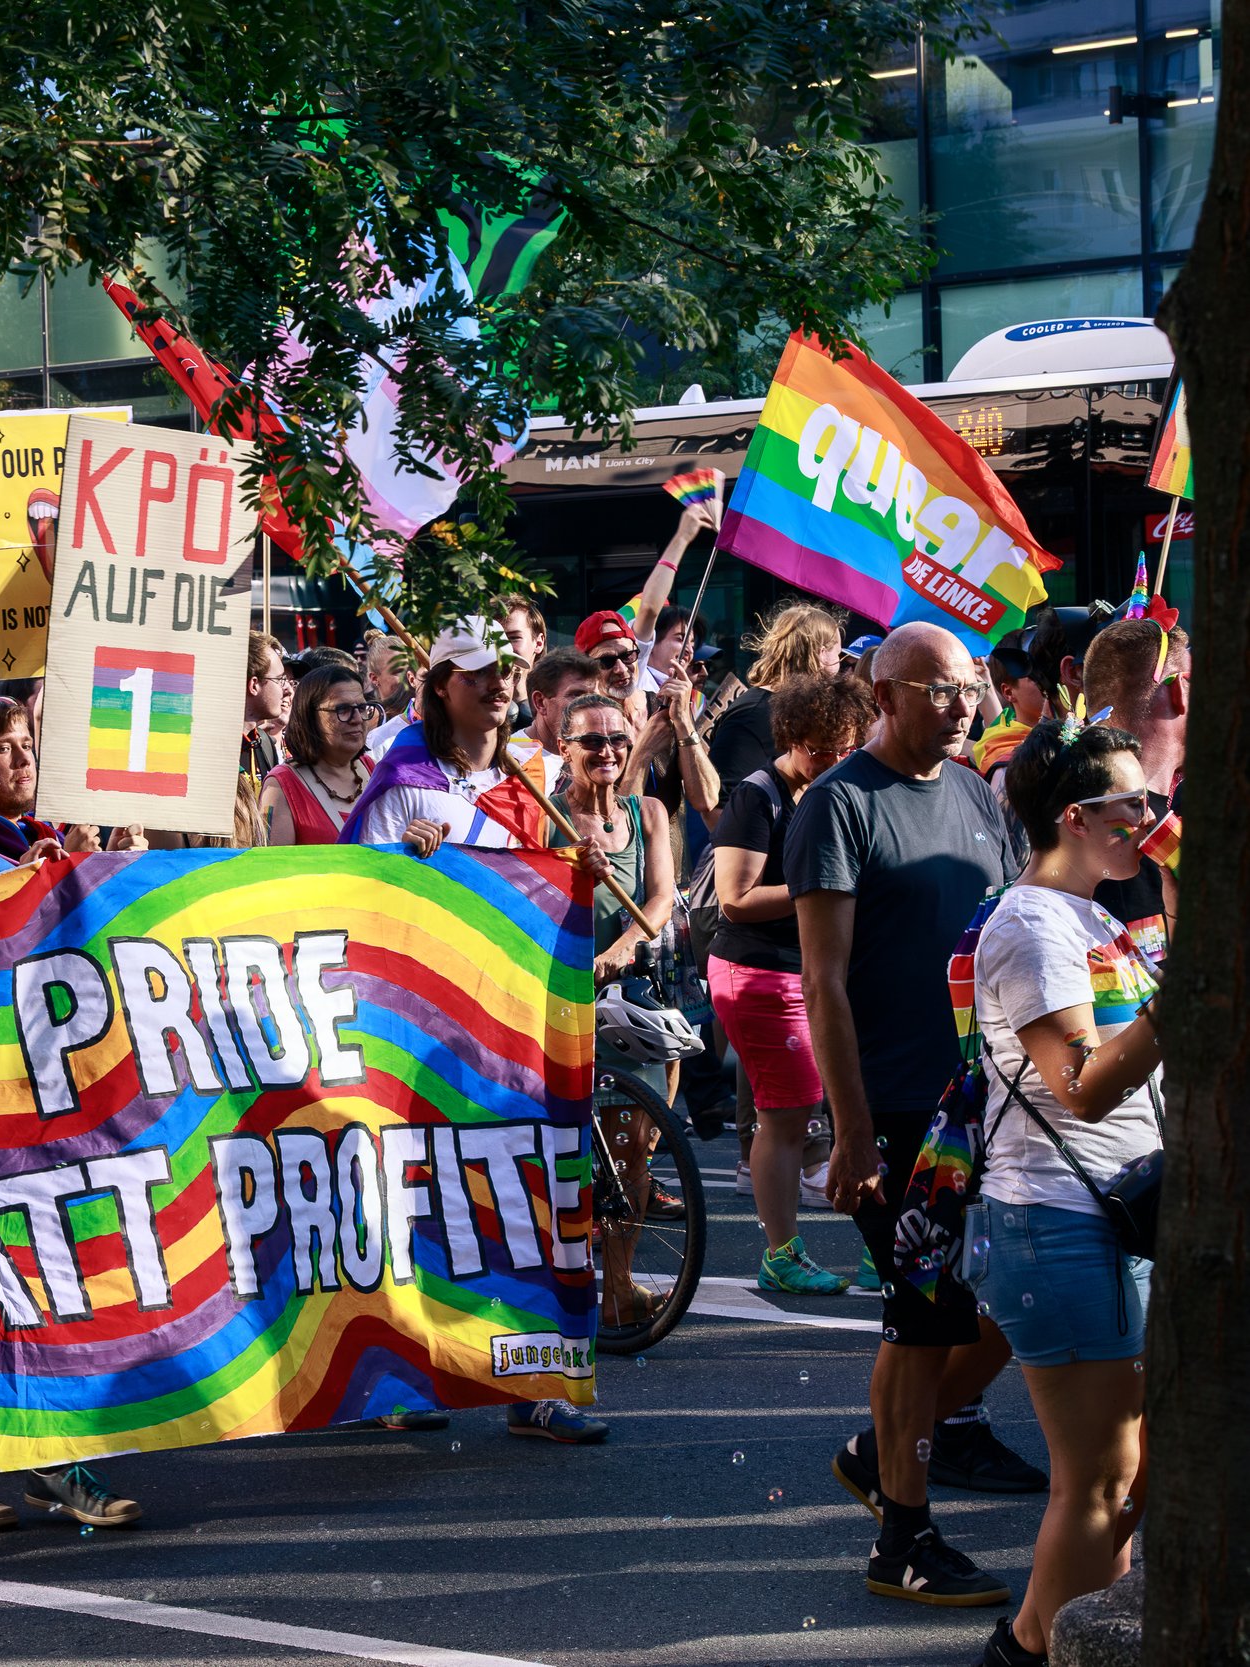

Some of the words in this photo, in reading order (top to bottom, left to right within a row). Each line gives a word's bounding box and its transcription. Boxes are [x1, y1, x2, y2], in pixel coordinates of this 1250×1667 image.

[1022, 323, 1064, 336] COOLED
[1, 447, 46, 479] OUR
[545, 454, 601, 473] MAN
[605, 459, 632, 468] Lion's
[634, 457, 655, 466] City
[72, 439, 235, 564] KPÖ
[797, 402, 1029, 590] queer
[903, 555, 933, 586] DIE
[1, 608, 18, 631] IS
[63, 560, 165, 626] AUF
[171, 571, 233, 637] DIE
[119, 667, 154, 773] 1
[12, 929, 366, 1121] PRIDE
[206, 1121, 592, 1301] PROFITE
[499, 1342, 562, 1373] junge
